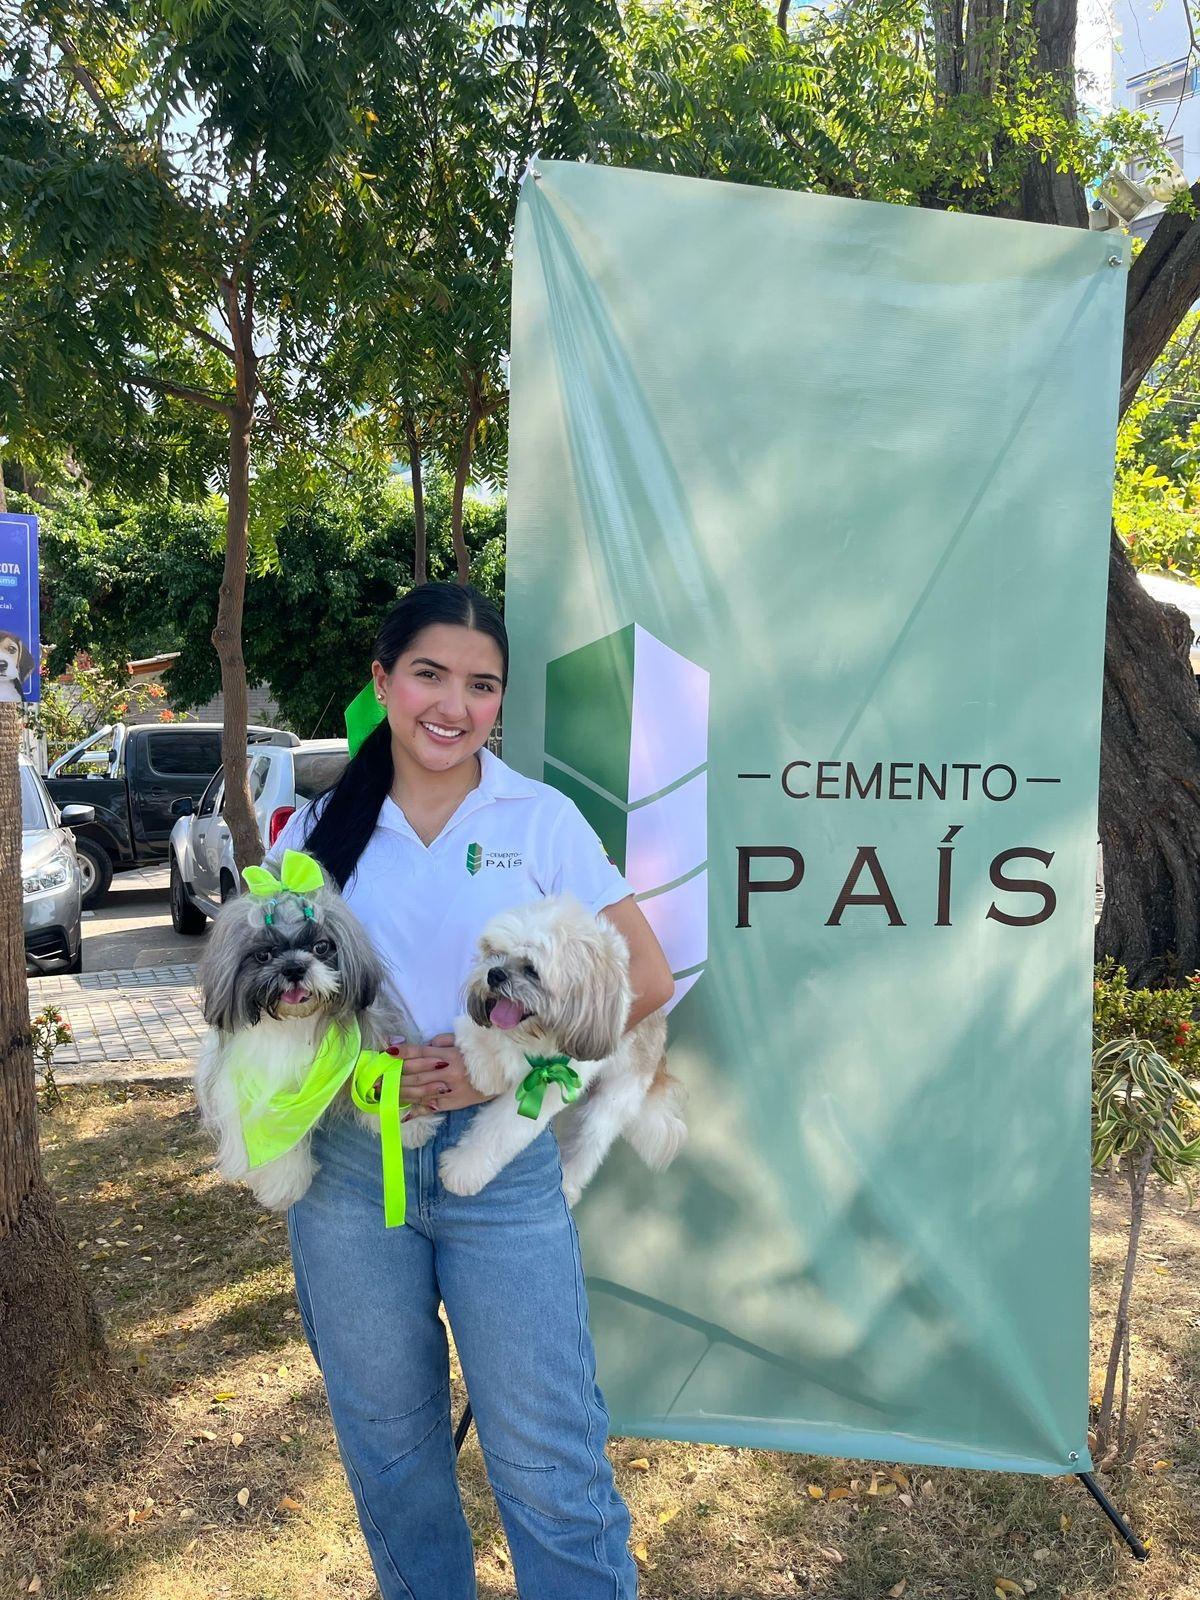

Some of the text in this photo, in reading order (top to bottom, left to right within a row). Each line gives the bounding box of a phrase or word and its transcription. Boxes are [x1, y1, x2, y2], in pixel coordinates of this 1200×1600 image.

[0, 563, 21, 575] OTA
[781, 760, 1018, 802] CEMENTO
[486, 858, 523, 869] PAÍS
[735, 824, 1057, 928] PAÍS
